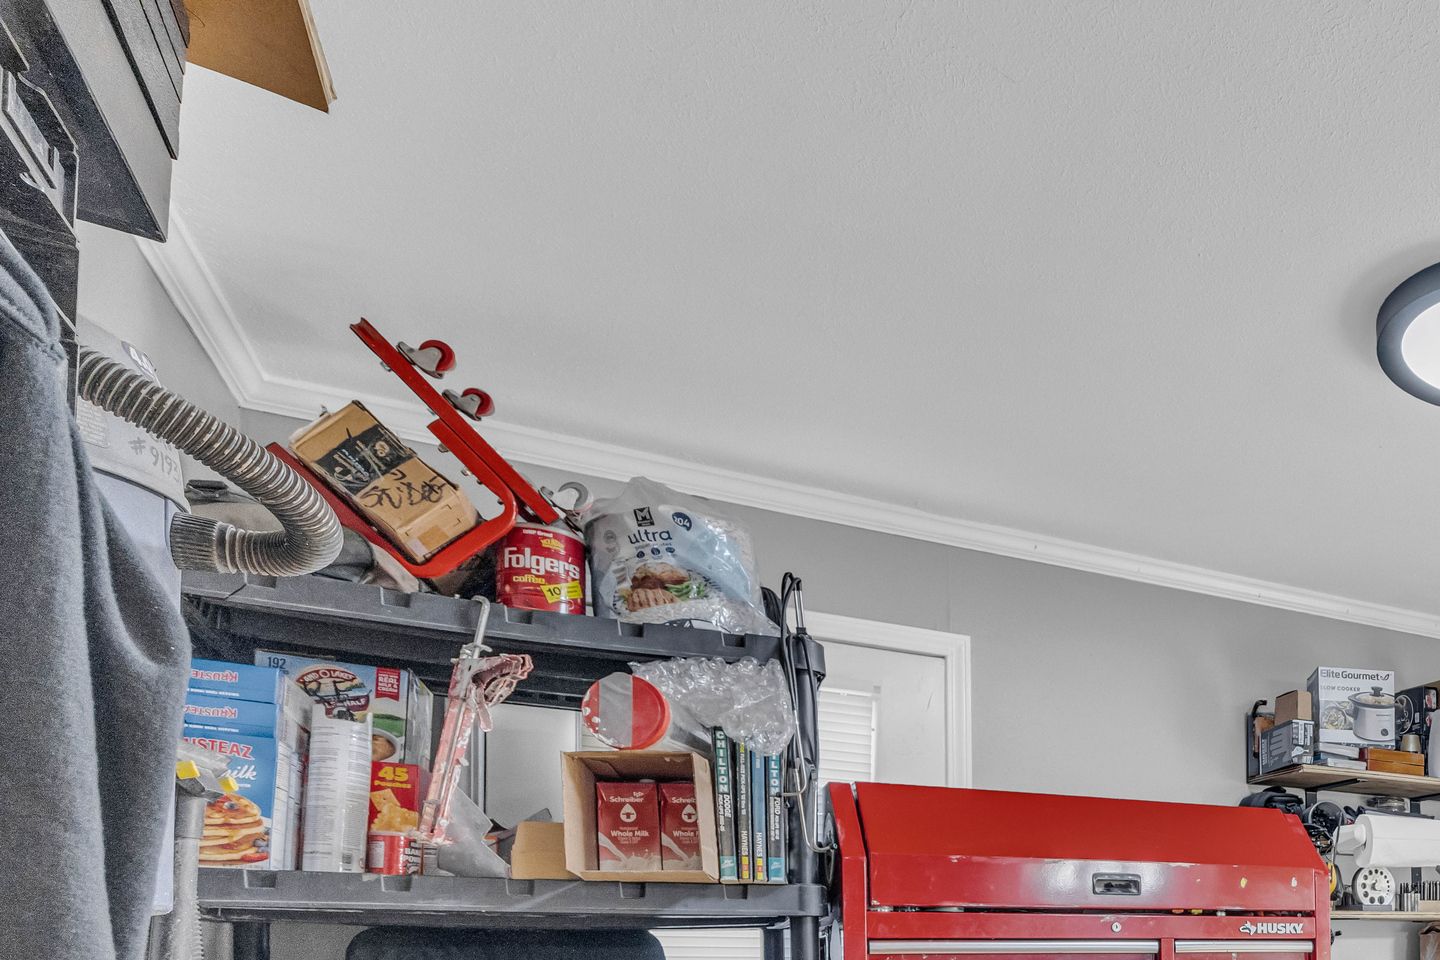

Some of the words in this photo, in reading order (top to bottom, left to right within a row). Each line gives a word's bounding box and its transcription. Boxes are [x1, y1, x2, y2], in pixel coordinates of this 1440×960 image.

[628, 529, 673, 545] ultra
[504, 547, 580, 579] Folger's
[513, 574, 546, 585] coffee
[268, 656, 287, 668] 192
[1320, 669, 1340, 678] Elite
[1341, 671, 1379, 681] Gourmet
[183, 738, 254, 760] USTEAZ
[715, 730, 729, 793] CHILTON
[378, 766, 409, 782] 45
[1257, 922, 1304, 934] HUSKY
